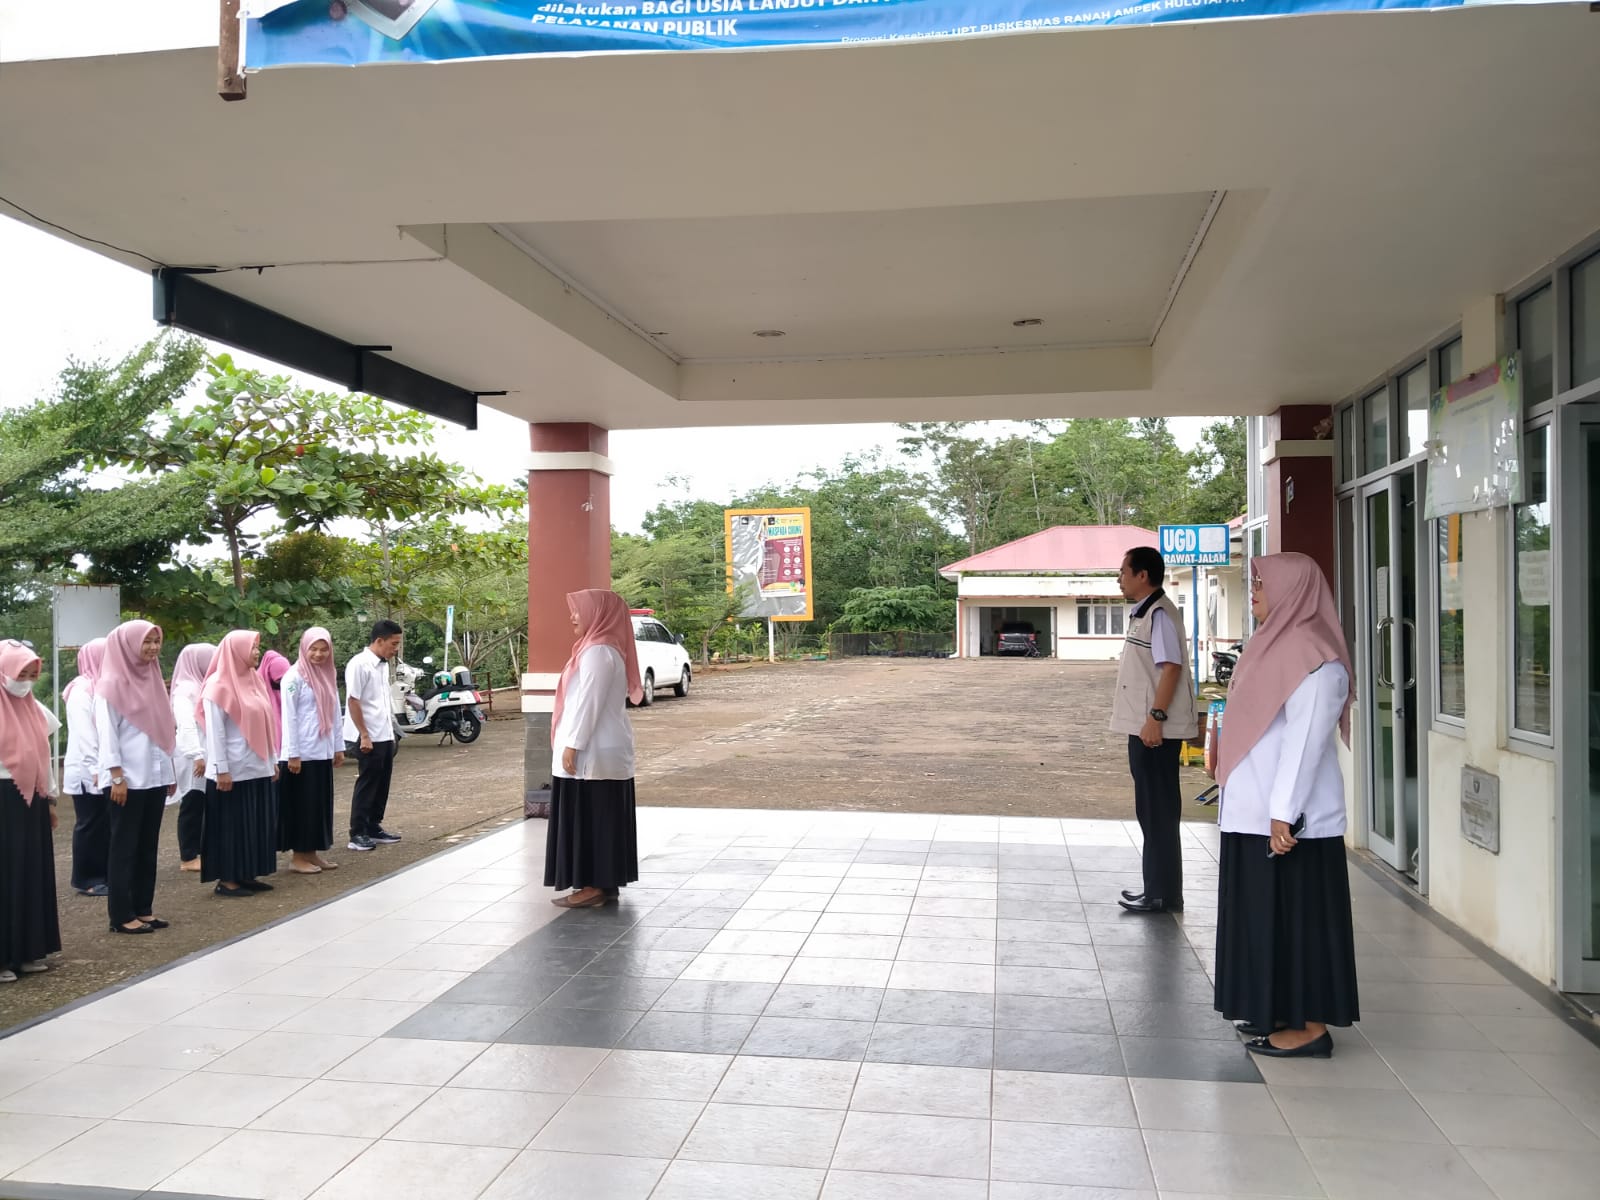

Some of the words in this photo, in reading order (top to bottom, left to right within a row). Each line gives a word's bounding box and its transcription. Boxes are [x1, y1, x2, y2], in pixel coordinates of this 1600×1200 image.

[537, 2, 636, 15] dilakukan
[642, 1, 691, 15] BAGI
[696, 0, 744, 13] USIA
[981, 16, 1060, 32] PUSKESMAS
[1064, 11, 1110, 24] RANAH
[1113, 1, 1161, 17] AMPEK
[531, 14, 658, 33] PELAYANAN
[663, 19, 738, 36] PUBLIK
[1164, 529, 1196, 552] UGD
[1164, 554, 1195, 563] RAWAT
[1198, 554, 1226, 563] JALAN
